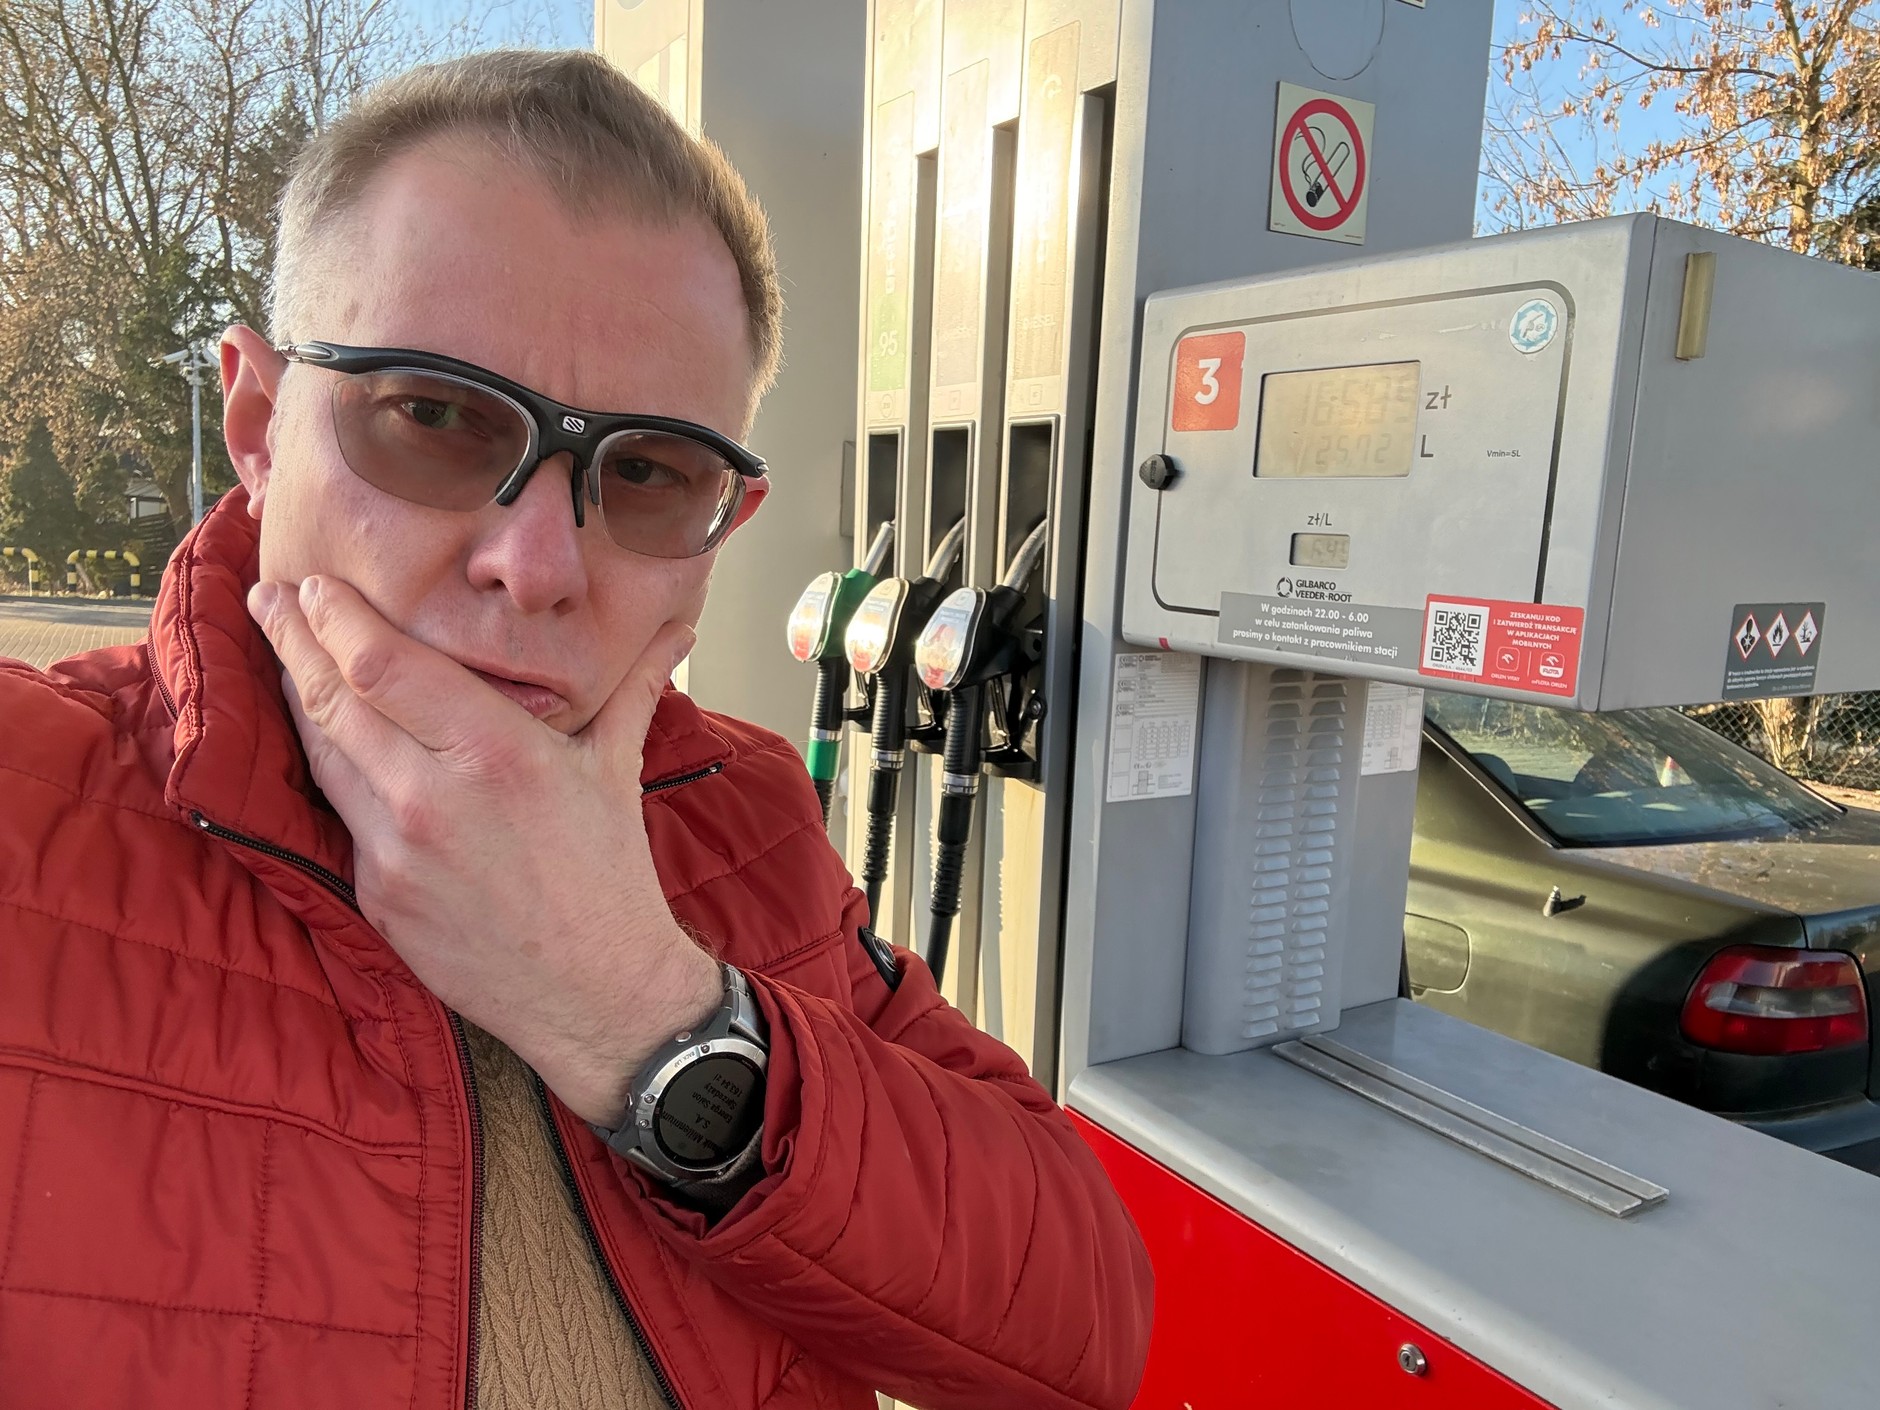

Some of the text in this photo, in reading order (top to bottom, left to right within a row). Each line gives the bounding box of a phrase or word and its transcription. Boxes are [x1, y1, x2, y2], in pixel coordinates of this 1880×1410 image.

[878, 330, 898, 356] 95
[1195, 358, 1221, 406] 3
[1425, 385, 1452, 410] zł
[1420, 434, 1434, 458] L
[1487, 450, 1521, 458] Vmin=5L
[1307, 513, 1332, 527] zł/L
[1296, 579, 1336, 591] GILBARCO
[1295, 590, 1352, 603] VEEDER-ROOT
[1261, 603, 1270, 612] W
[1271, 605, 1313, 617] godzinach
[1315, 608, 1340, 620] 22.00
[1348, 612, 1369, 623] 6.00
[1510, 611, 1561, 623] ZESKANUJ KOD
[1255, 618, 1373, 639] w celu zatankowania paliwa
[1515, 630, 1560, 641] APLIKACJACH
[1535, 623, 1577, 635] TRANSAKCJĘ
[1233, 629, 1398, 659] prosimy o kontakt z pracownikiem stacji
[1512, 639, 1552, 650] MOBILNYCH
